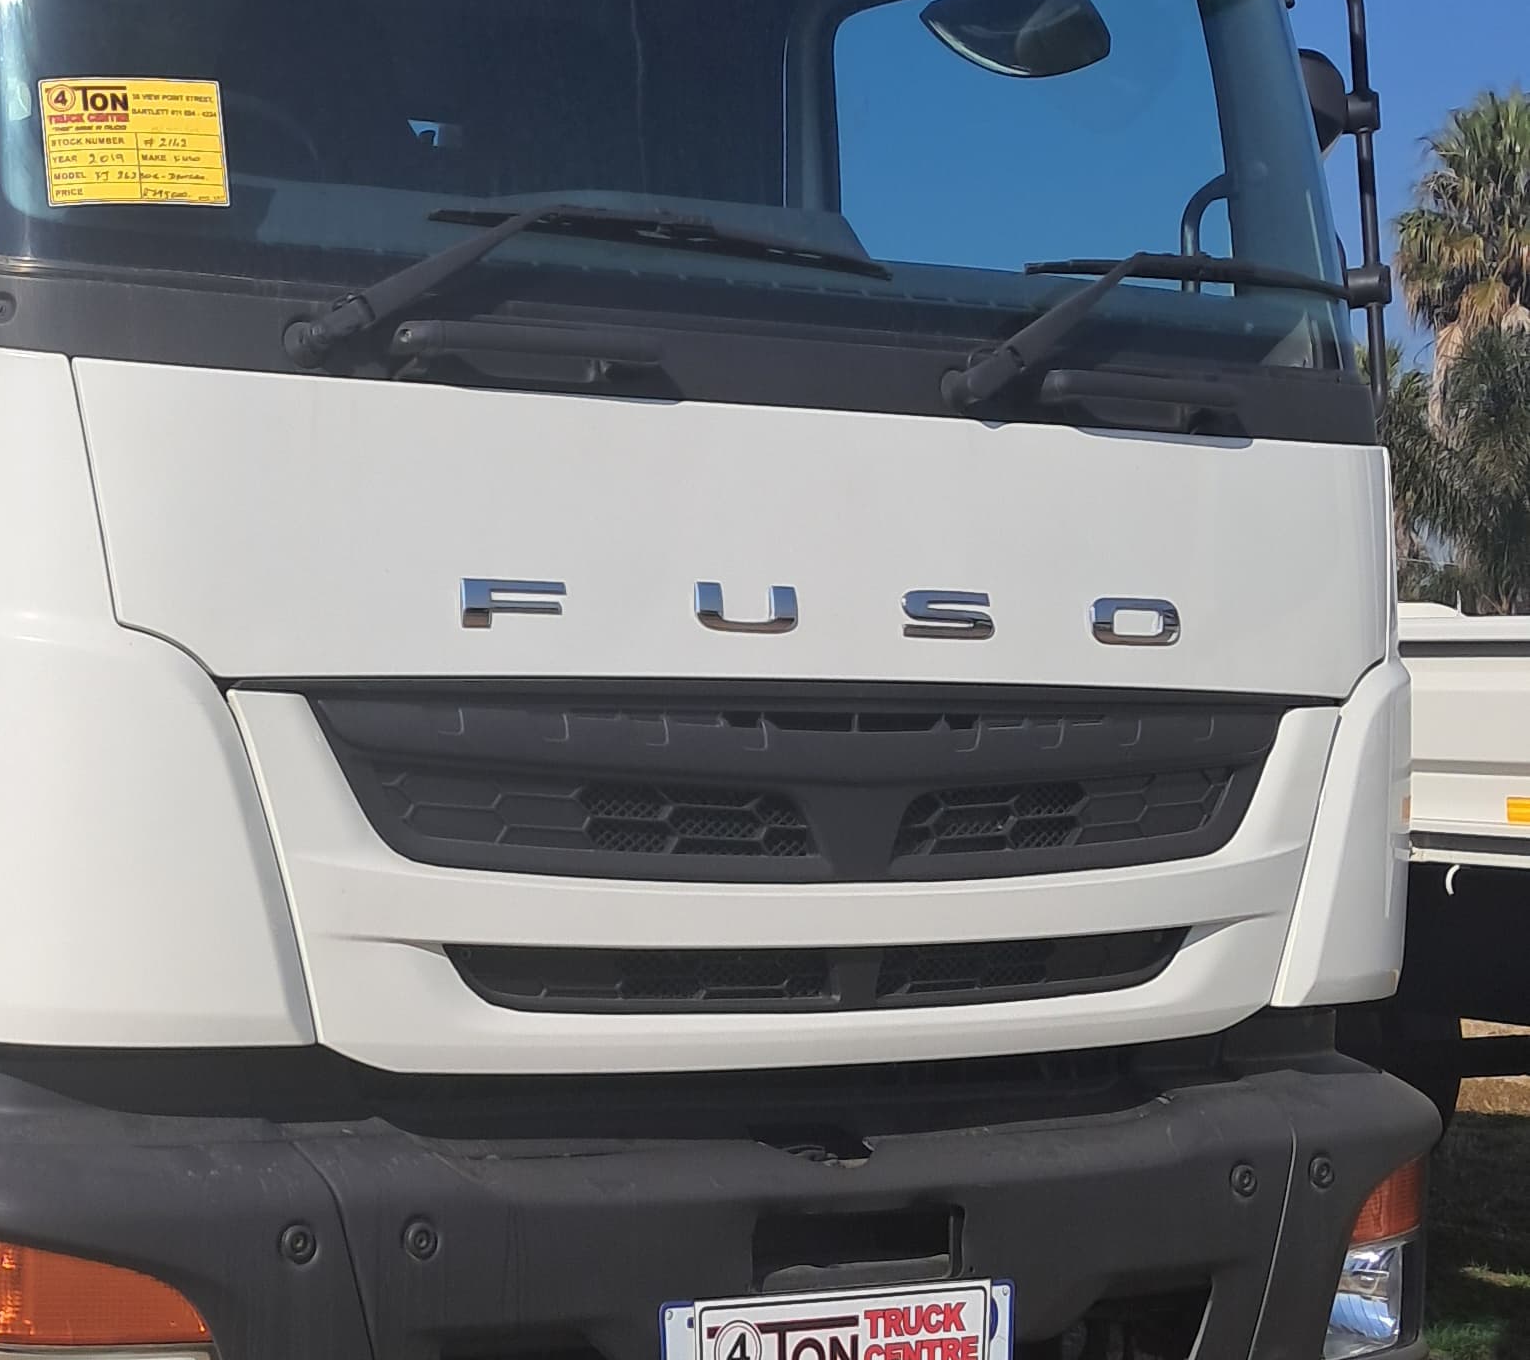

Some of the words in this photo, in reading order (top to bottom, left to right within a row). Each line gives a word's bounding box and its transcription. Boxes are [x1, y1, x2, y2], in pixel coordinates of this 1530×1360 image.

[76, 86, 129, 112] TON
[47, 114, 85, 125] TRUCK
[51, 138, 82, 147] STOCK
[85, 137, 125, 145] NUMBER
[52, 155, 78, 163] YEAR
[88, 153, 125, 164] 2019
[141, 154, 167, 162] MAKE
[54, 171, 86, 180] MODEL
[55, 188, 84, 197] PRICE
[459, 577, 1182, 648] FUSO
[863, 1301, 967, 1340] TRUCK
